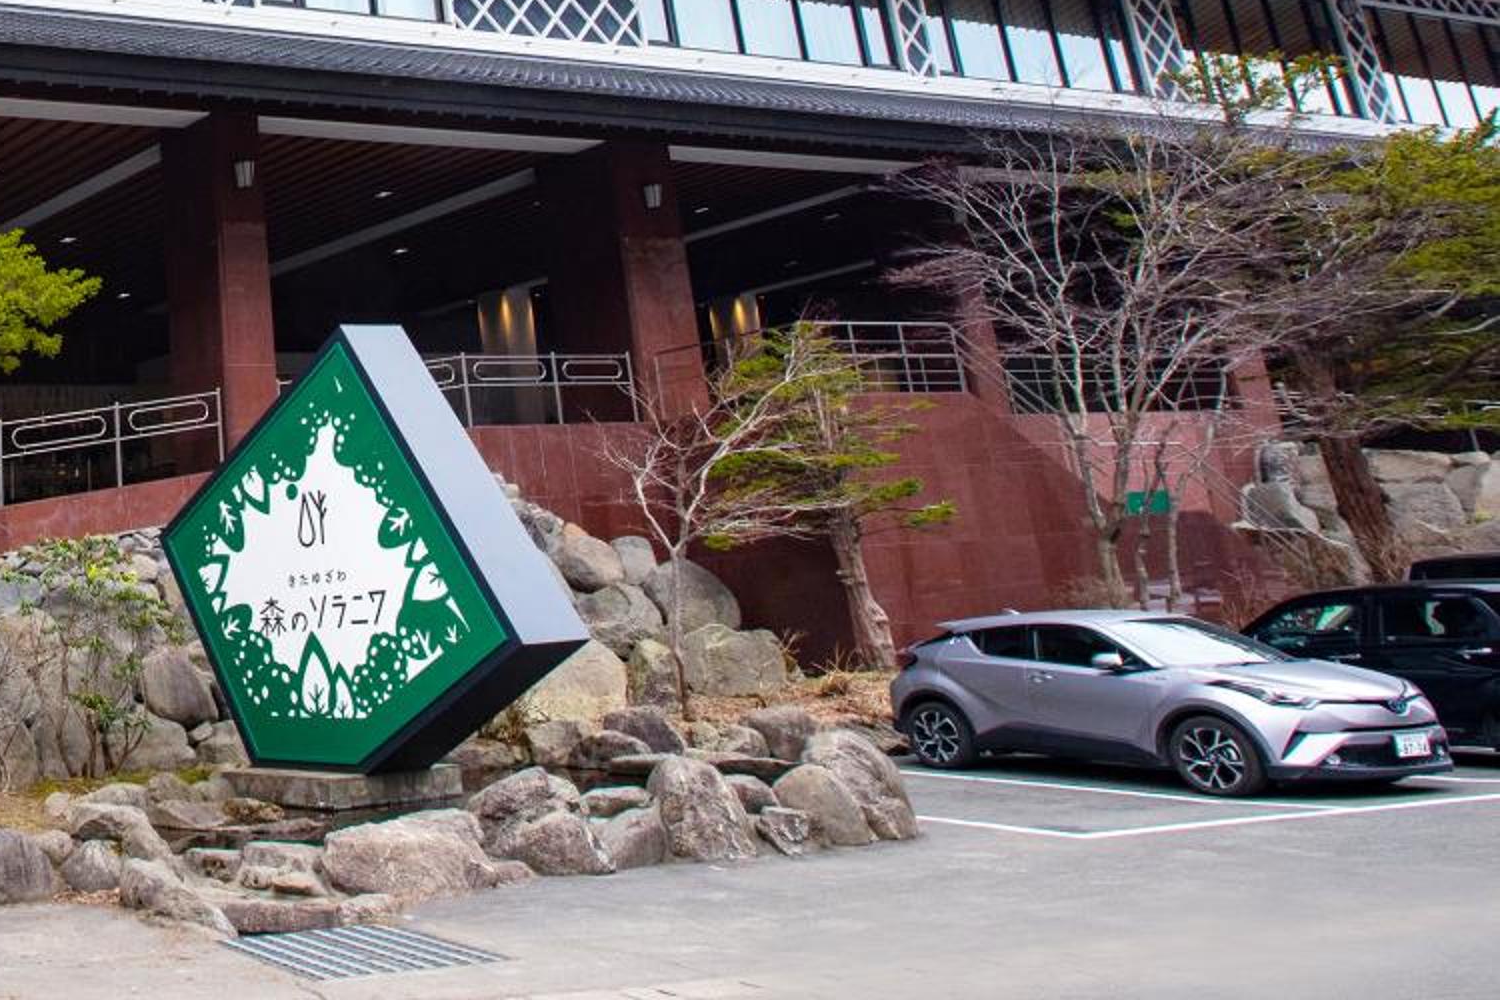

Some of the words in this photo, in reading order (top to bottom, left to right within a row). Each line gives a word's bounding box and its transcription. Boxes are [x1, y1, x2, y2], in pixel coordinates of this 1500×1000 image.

[288, 568, 347, 588] きたゆざわ
[259, 589, 387, 637] 森のソラニワ
